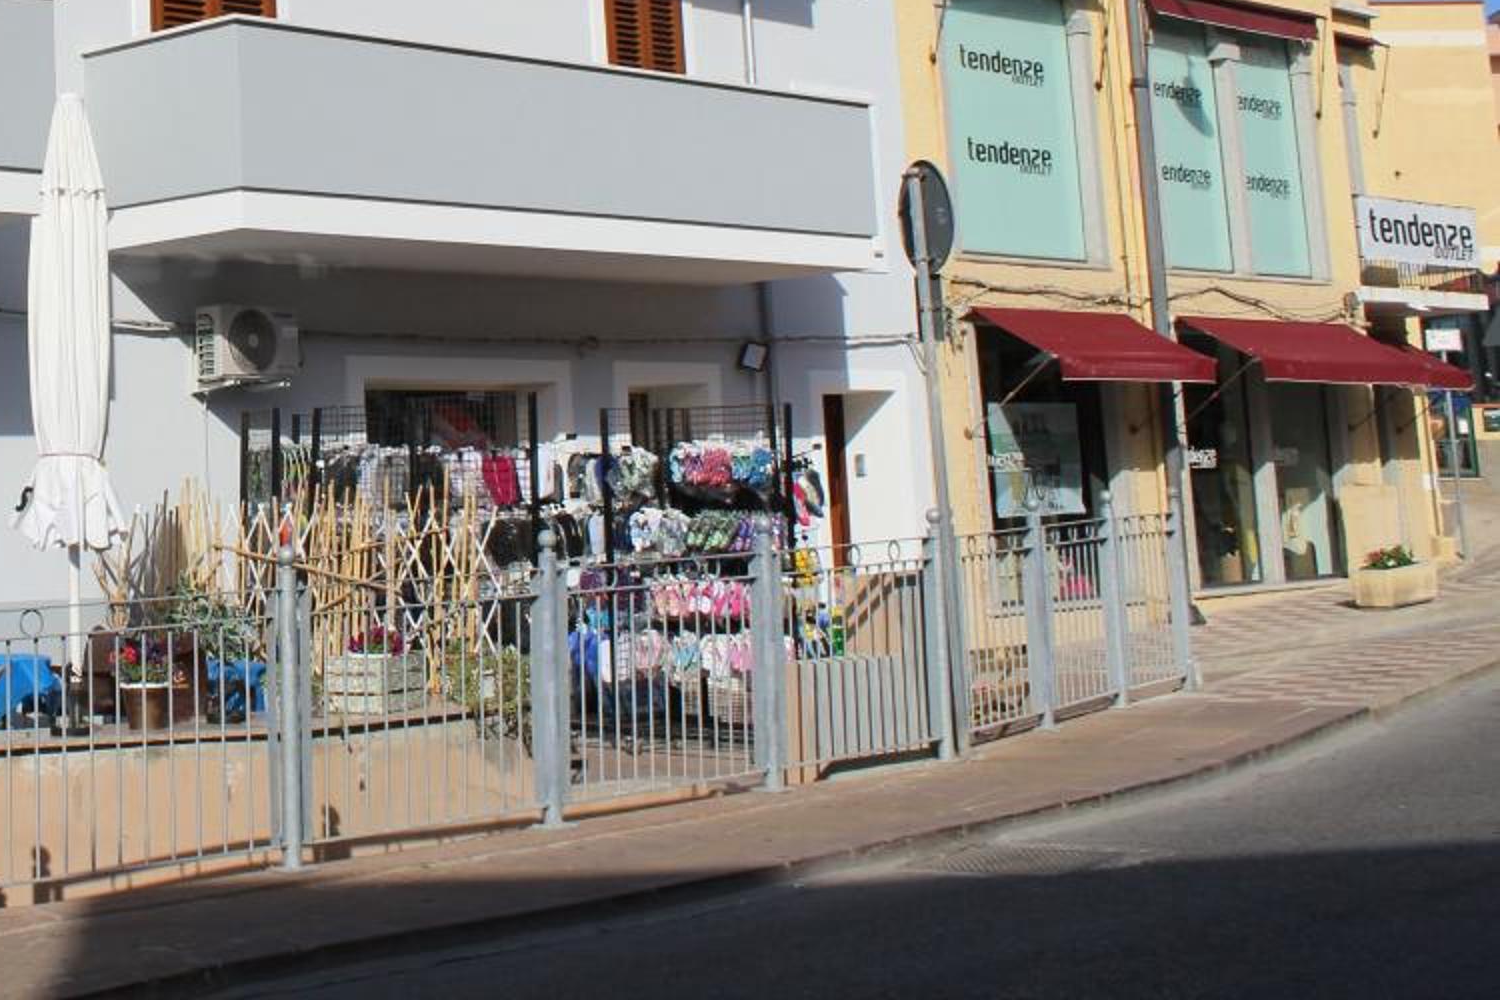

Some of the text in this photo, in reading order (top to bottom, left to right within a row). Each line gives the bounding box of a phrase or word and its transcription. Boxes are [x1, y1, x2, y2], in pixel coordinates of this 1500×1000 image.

[959, 43, 1044, 77] tendenze
[967, 136, 1052, 168] tendenze
[1161, 163, 1212, 187] endenze
[1369, 207, 1473, 249] tendenze
